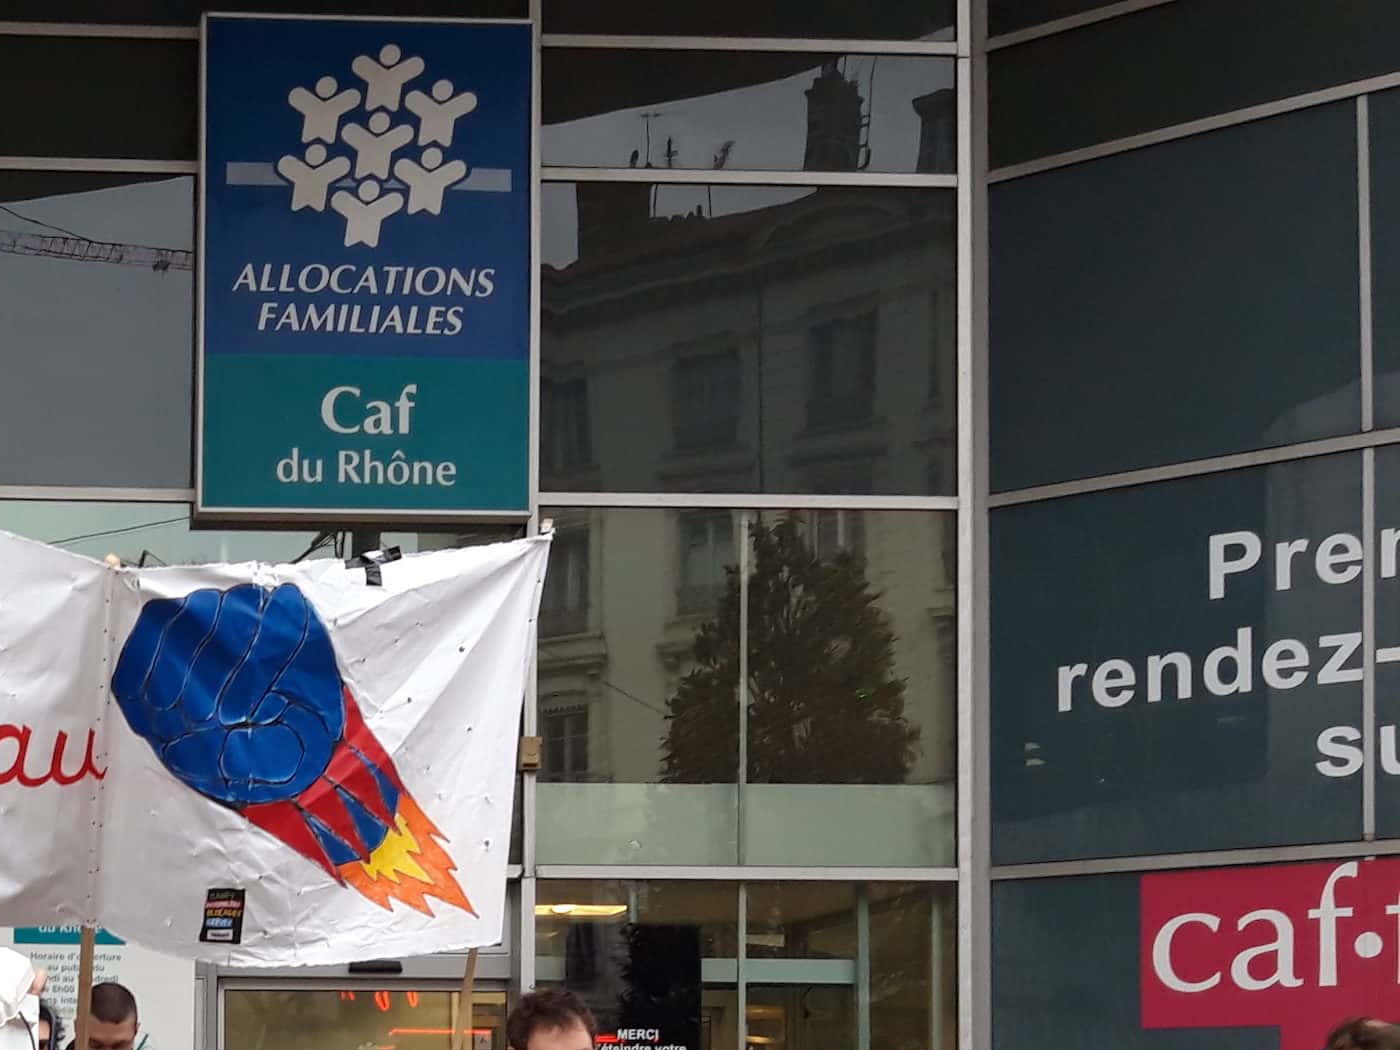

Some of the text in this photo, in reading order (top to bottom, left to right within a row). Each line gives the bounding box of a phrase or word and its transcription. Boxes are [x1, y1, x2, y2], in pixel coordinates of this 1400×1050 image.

[232, 262, 496, 298] ALLOCATIONS
[257, 301, 464, 336] FAMILIALES
[320, 383, 418, 434] Caf
[276, 447, 457, 486] du Rhône
[616, 1028, 659, 1041] MERCI
